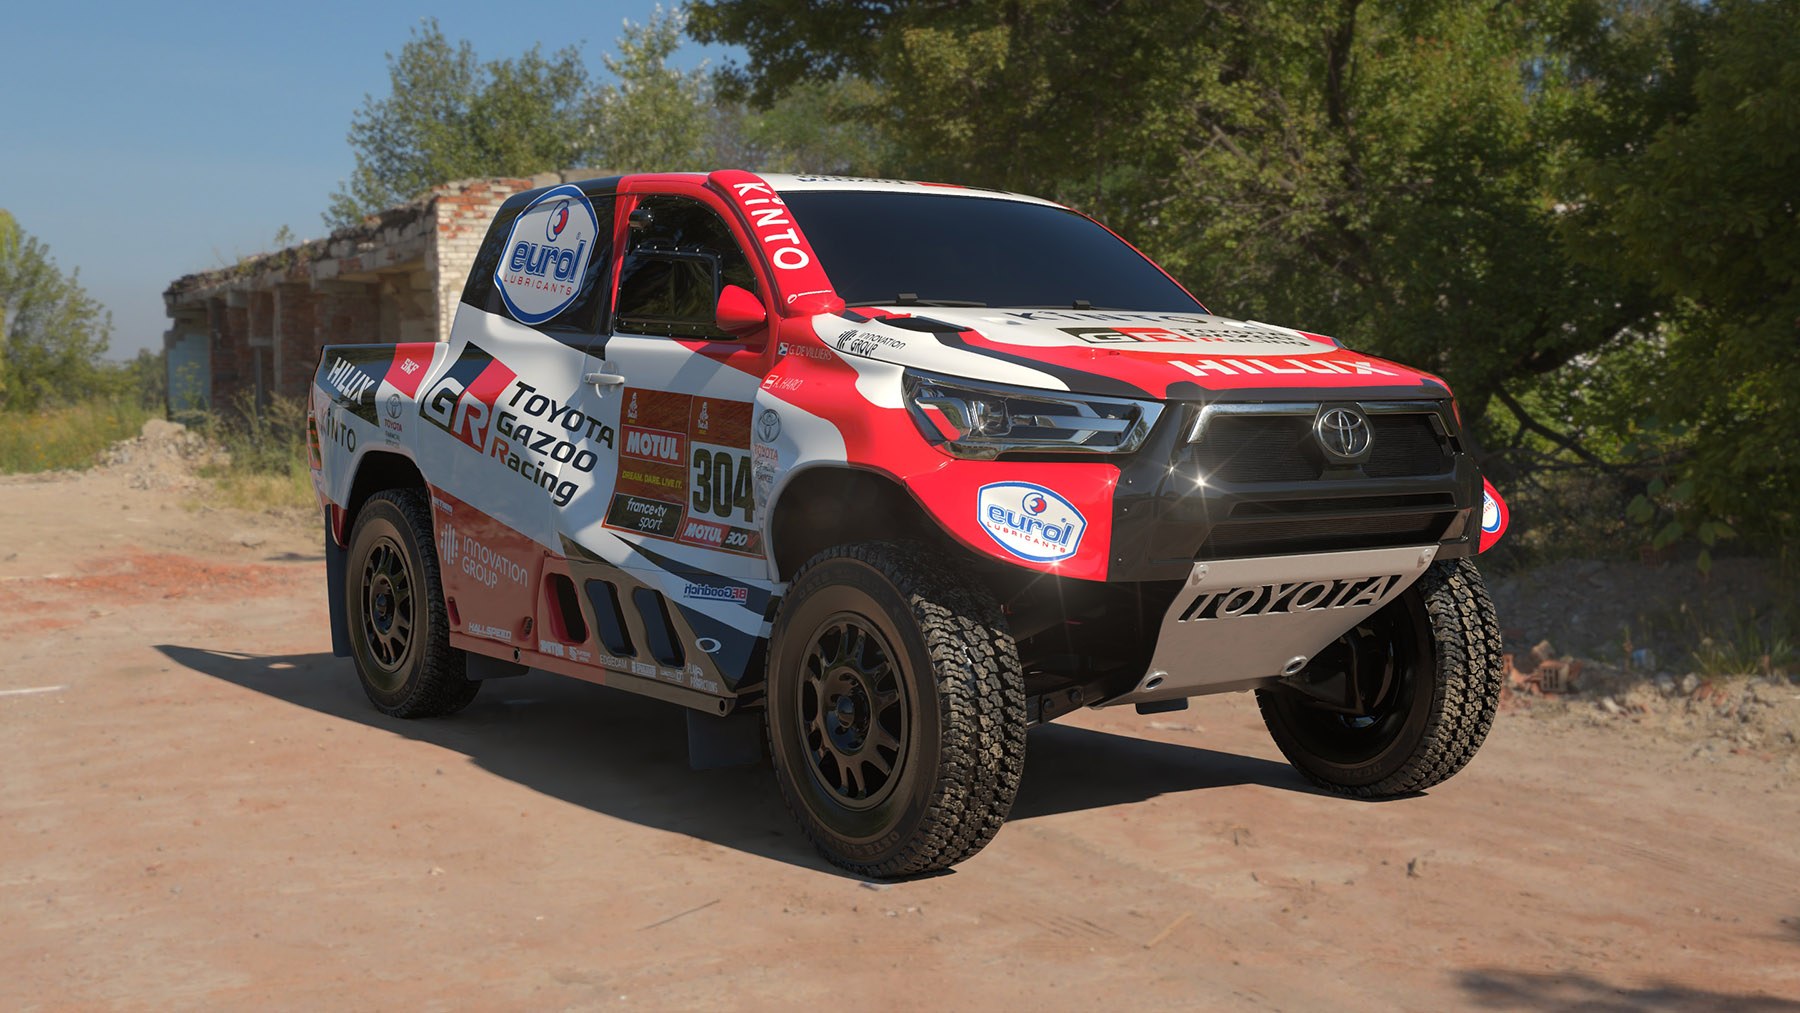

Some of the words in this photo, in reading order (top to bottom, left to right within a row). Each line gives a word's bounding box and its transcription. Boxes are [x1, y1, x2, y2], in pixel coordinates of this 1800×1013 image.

[509, 239, 586, 283] eurol
[503, 274, 573, 296] LUBRICANTS
[850, 338, 879, 357] GROUP
[1078, 332, 1190, 342] GR
[327, 356, 375, 406] HILUX
[400, 358, 420, 375] SKF
[1169, 359, 1399, 377] HILUX
[384, 418, 403, 433] TOYOTA
[423, 376, 491, 449] GR
[508, 381, 616, 450] TOYOTA
[496, 411, 599, 473] GAZOO
[626, 431, 680, 461] MOTUL
[490, 436, 579, 508] Racing
[692, 448, 756, 523] 304
[638, 515, 663, 531] sport
[684, 522, 723, 543] MOTUL
[986, 521, 1067, 554] LUBRICANTS
[987, 504, 1075, 547] eurol
[462, 556, 498, 588] GROUP
[1180, 574, 1402, 622] TOYOTA
